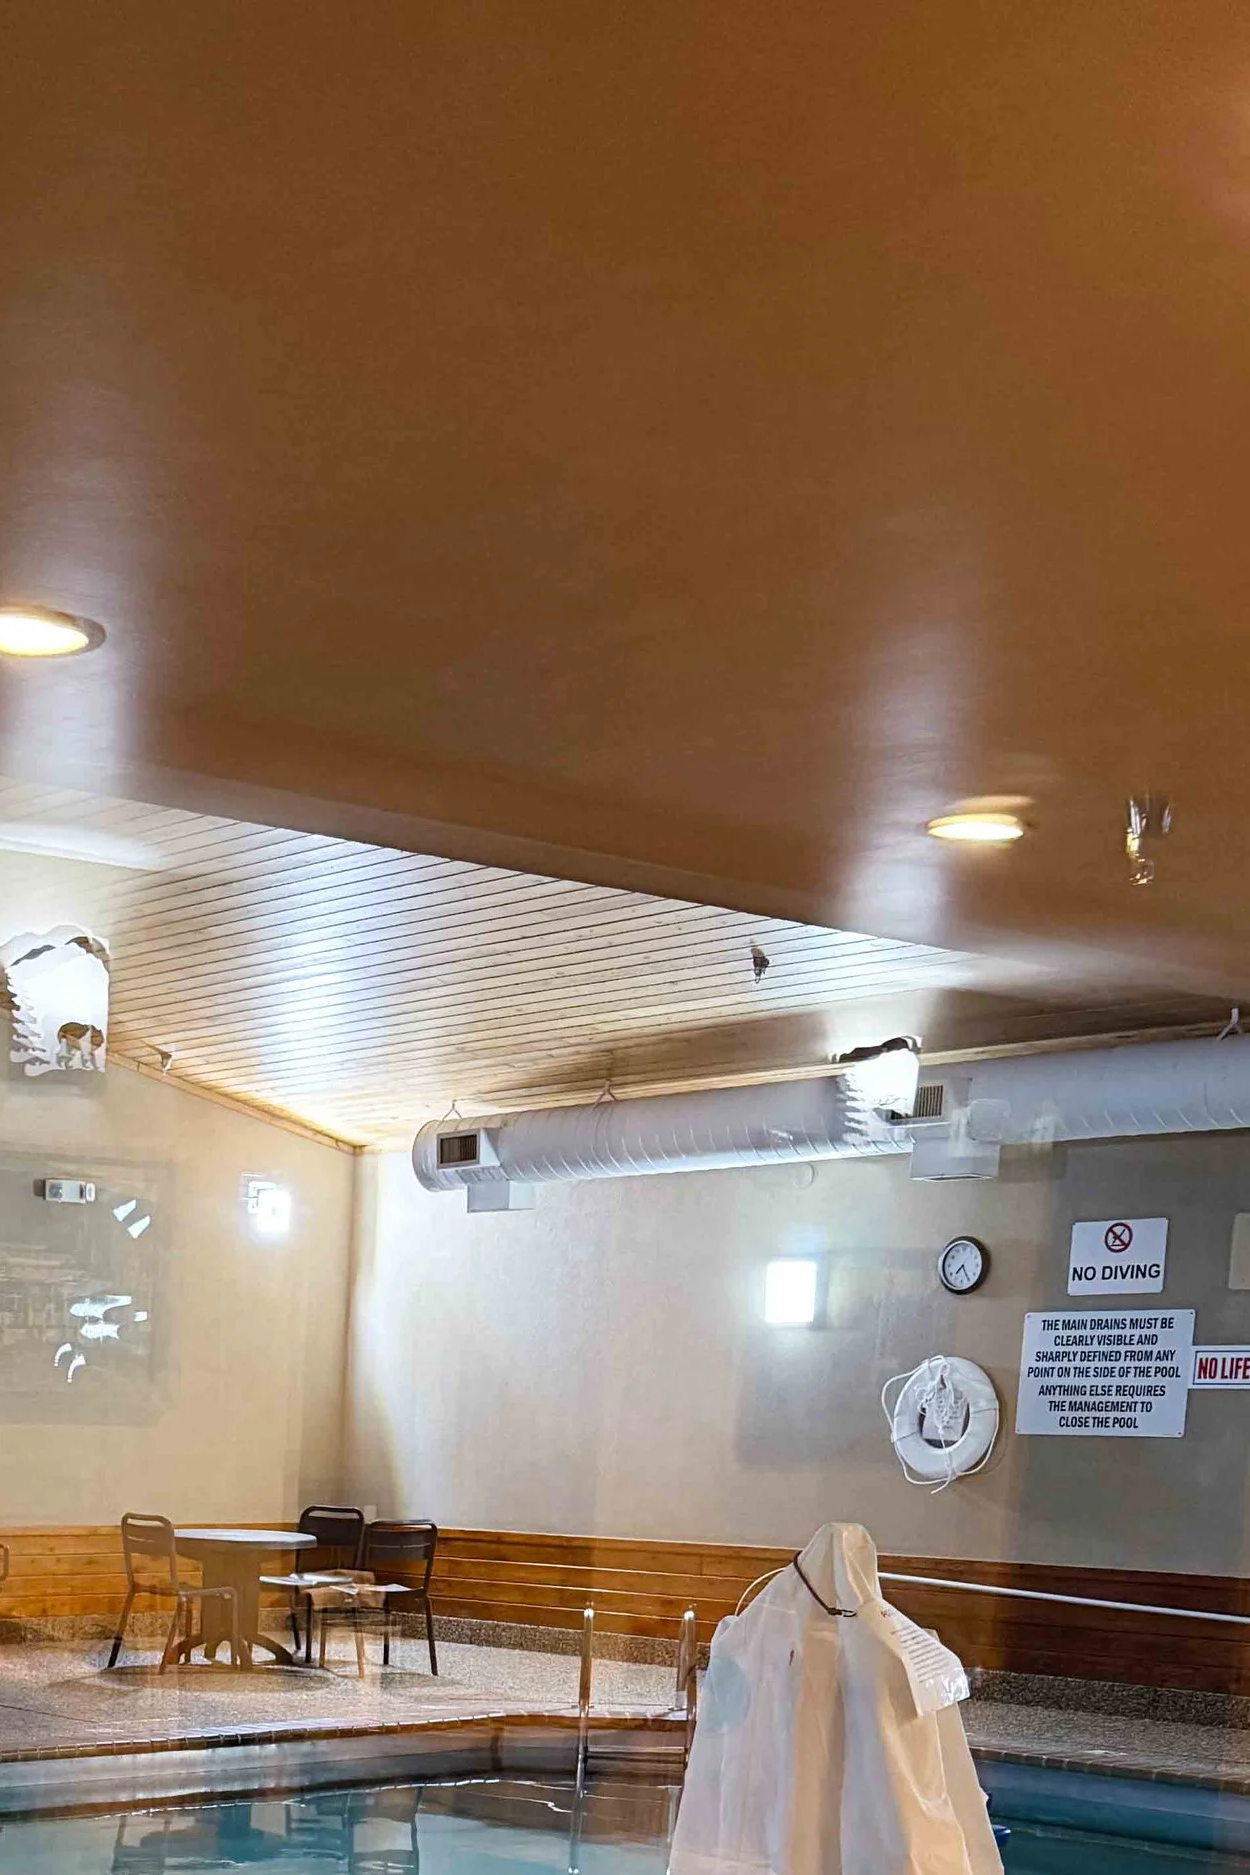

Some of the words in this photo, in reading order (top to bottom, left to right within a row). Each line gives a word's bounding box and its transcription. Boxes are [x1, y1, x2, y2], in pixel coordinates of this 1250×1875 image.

[1072, 1266, 1096, 1281] NO
[1101, 1263, 1161, 1281] DIVING
[1042, 1319, 1060, 1331] THE
[1061, 1319, 1087, 1331] MAIN
[1089, 1318, 1127, 1330] DRAINS
[1129, 1317, 1159, 1330] MUST
[1160, 1317, 1175, 1329] BE
[1054, 1335, 1095, 1347] CLEARLY
[1096, 1334, 1135, 1346] VISIBLE
[1136, 1334, 1159, 1346] AND
[1035, 1351, 1079, 1362] SHARPLY
[1079, 1350, 1121, 1362] DEFINED
[1123, 1350, 1153, 1362] FROM
[1154, 1350, 1176, 1362] ANY
[1027, 1366, 1056, 1378] POINT
[1057, 1366, 1071, 1378] ON
[1073, 1366, 1091, 1378] THE
[1092, 1366, 1116, 1378] SIDE
[1118, 1366, 1131, 1378] OF
[1132, 1366, 1152, 1378] THE
[1153, 1366, 1181, 1378] POOL
[1197, 1357, 1218, 1379] NO
[1220, 1357, 1250, 1379] LIFE
[1038, 1385, 1087, 1397] ANYTHING
[1089, 1385, 1113, 1397] ELSE
[1115, 1385, 1166, 1398] REQUIRES
[1048, 1401, 1066, 1412] THE
[1068, 1401, 1138, 1413] MANAGEMENT
[1140, 1401, 1153, 1413] TO
[1059, 1416, 1090, 1428] CLOSE
[1091, 1416, 1110, 1428] THE
[1112, 1417, 1139, 1429] POOL
